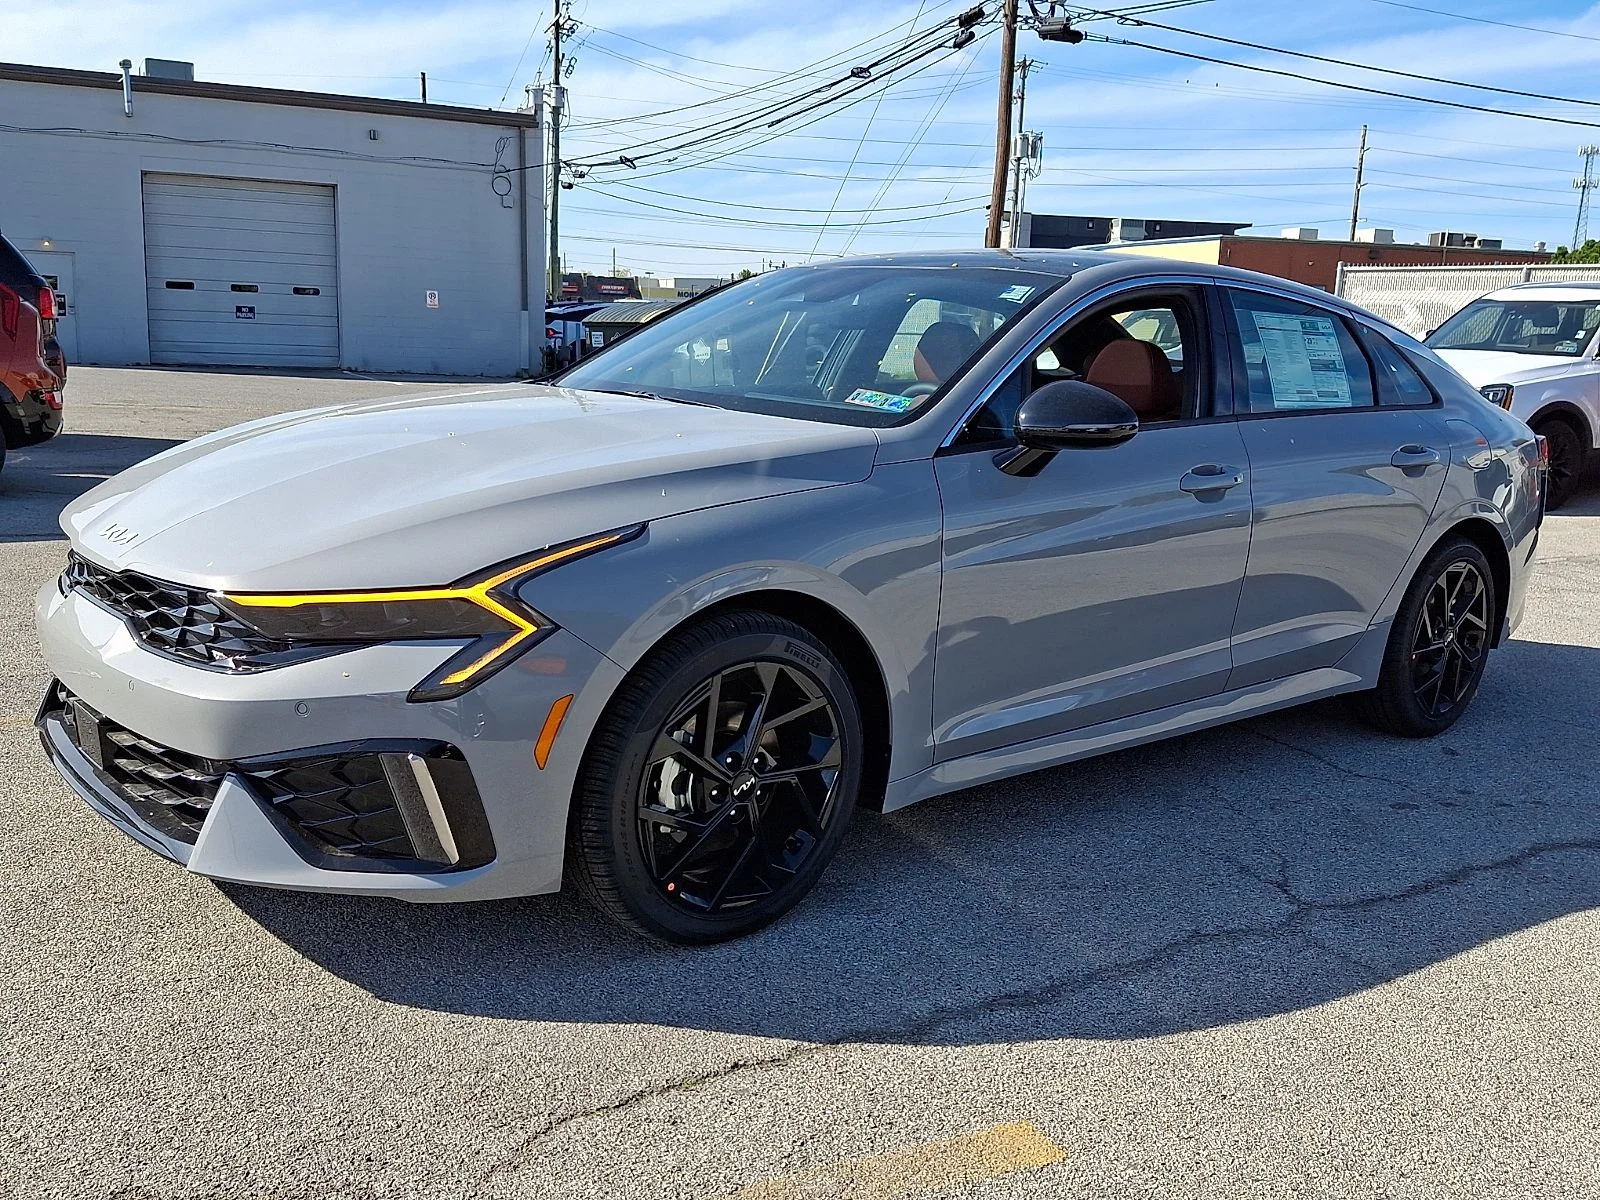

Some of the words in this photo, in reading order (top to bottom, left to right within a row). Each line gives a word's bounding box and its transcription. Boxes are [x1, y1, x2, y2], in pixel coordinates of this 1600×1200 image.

[99, 523, 139, 546] KIA
[784, 640, 822, 669] PIRELLI
[733, 776, 755, 796] KIA
